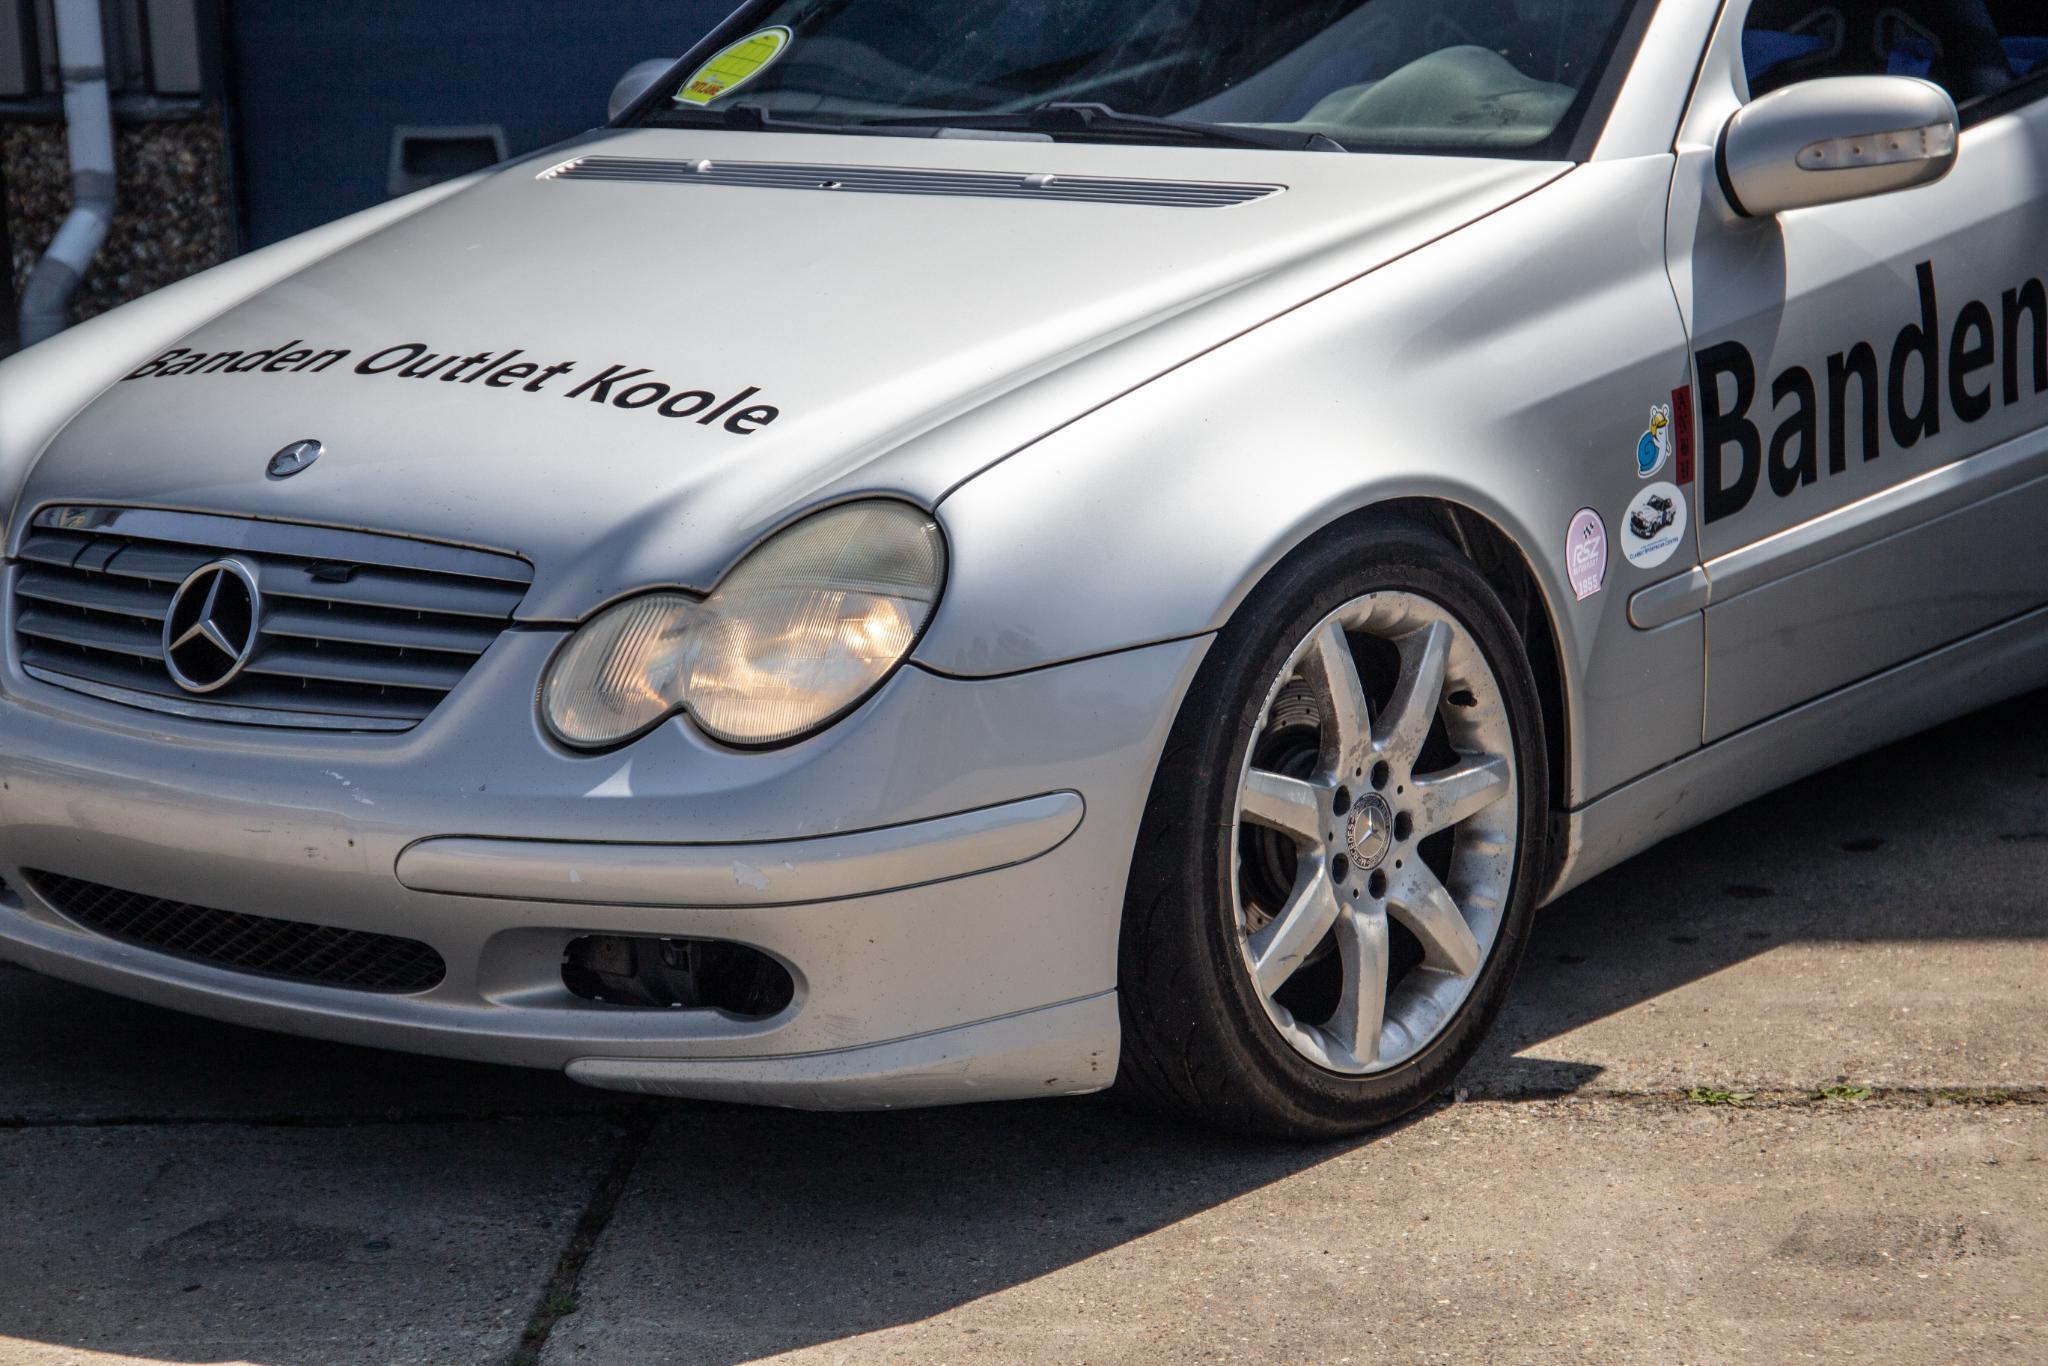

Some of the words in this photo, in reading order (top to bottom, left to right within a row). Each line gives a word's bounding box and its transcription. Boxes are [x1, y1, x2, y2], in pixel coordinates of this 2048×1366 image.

[120, 339, 352, 382] Banden
[354, 342, 578, 393] Outlet
[563, 363, 781, 436] Koole
[1694, 259, 2048, 526] Banden
